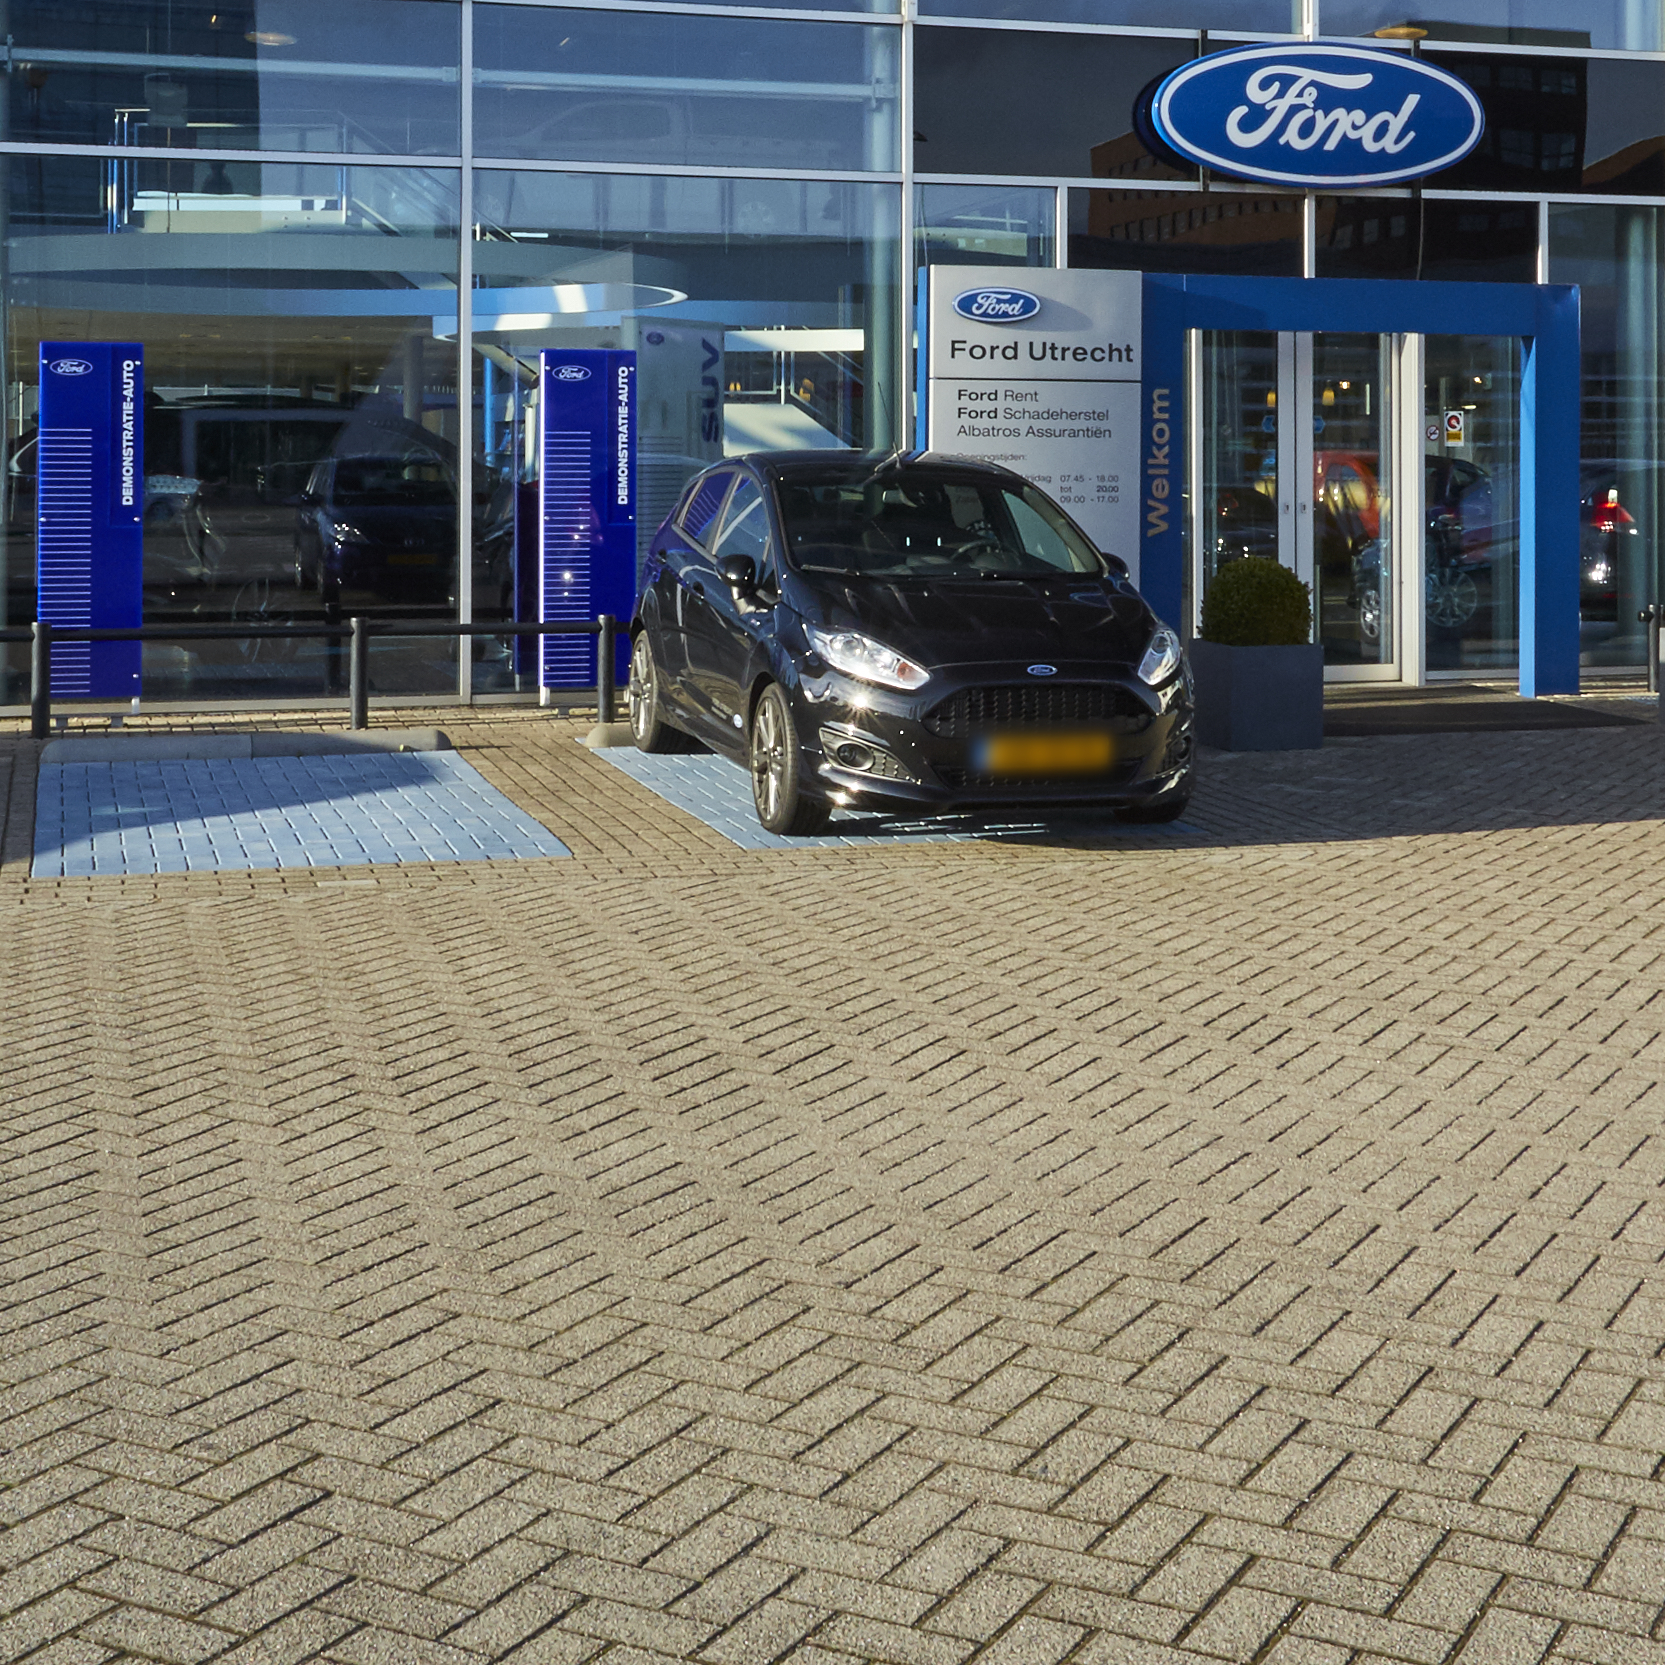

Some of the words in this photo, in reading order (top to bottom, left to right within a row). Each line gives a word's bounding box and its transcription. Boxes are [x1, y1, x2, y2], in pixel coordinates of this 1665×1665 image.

[1226, 65, 1421, 155] Ford
[972, 292, 1025, 316] Ford
[950, 339, 1019, 360] Ford
[1028, 341, 1134, 363] Utrecht
[57, 362, 84, 374] Ford
[560, 368, 584, 379] Ford
[701, 337, 720, 443] SUV
[957, 389, 998, 402] Ford
[1004, 390, 1039, 403] Rent
[957, 407, 998, 420] Ford
[1003, 407, 1109, 422] Schadeherstel
[122, 360, 134, 506] DEMONSTRATIE-AUTO
[617, 366, 629, 505] DEMONSTRATIE-AUTO
[957, 424, 1021, 438] Albatros
[1025, 425, 1112, 439] Assurantiën
[1147, 388, 1170, 538] Welkom
